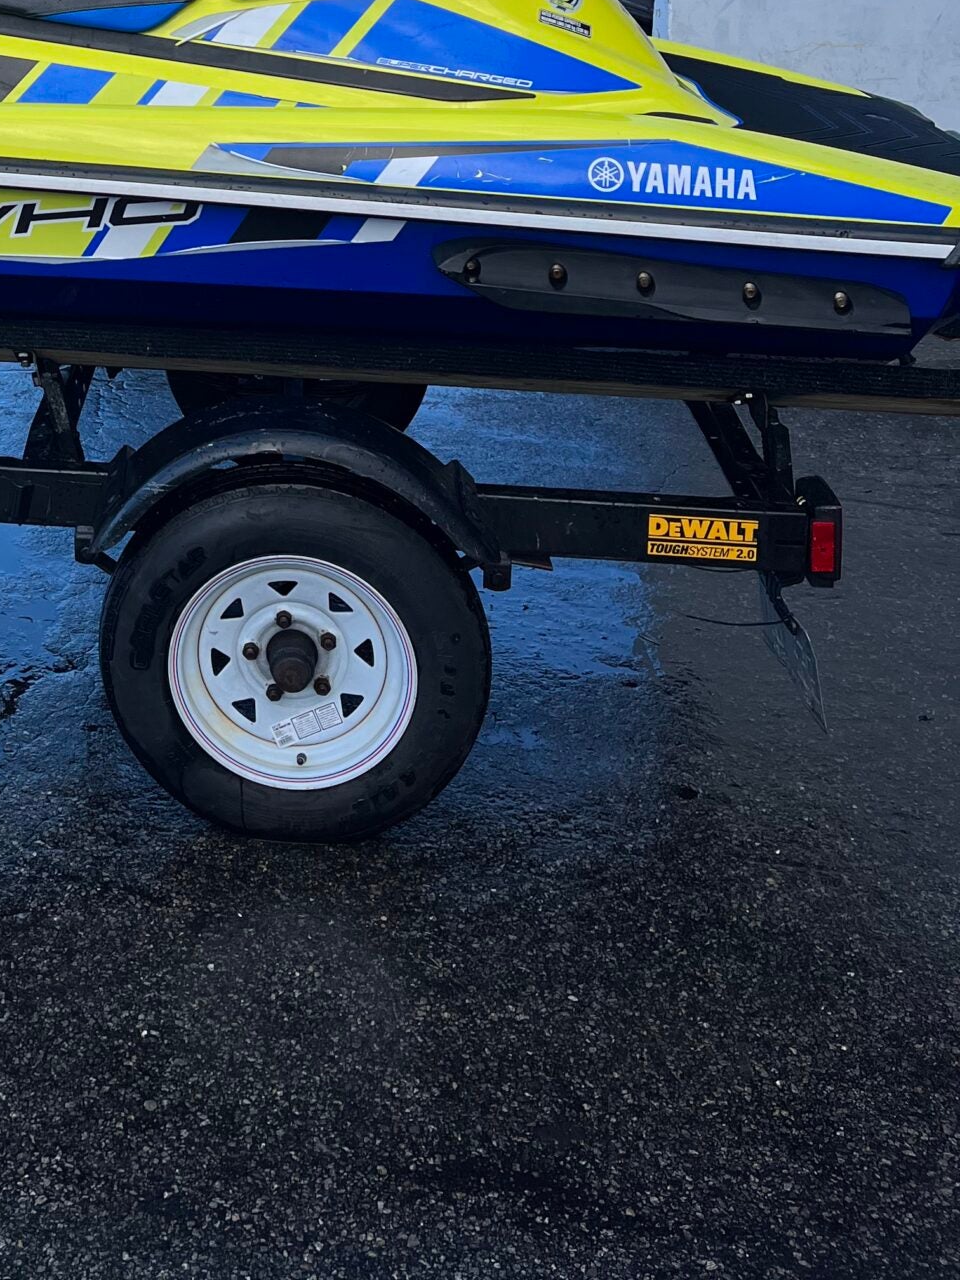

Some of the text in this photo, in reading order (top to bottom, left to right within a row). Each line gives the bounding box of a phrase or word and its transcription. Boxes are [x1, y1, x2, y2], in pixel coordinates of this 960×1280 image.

[376, 57, 533, 88] SUPERCHARGED
[627, 161, 757, 200] YAMAHA
[736, 549, 754, 559] 2.0
